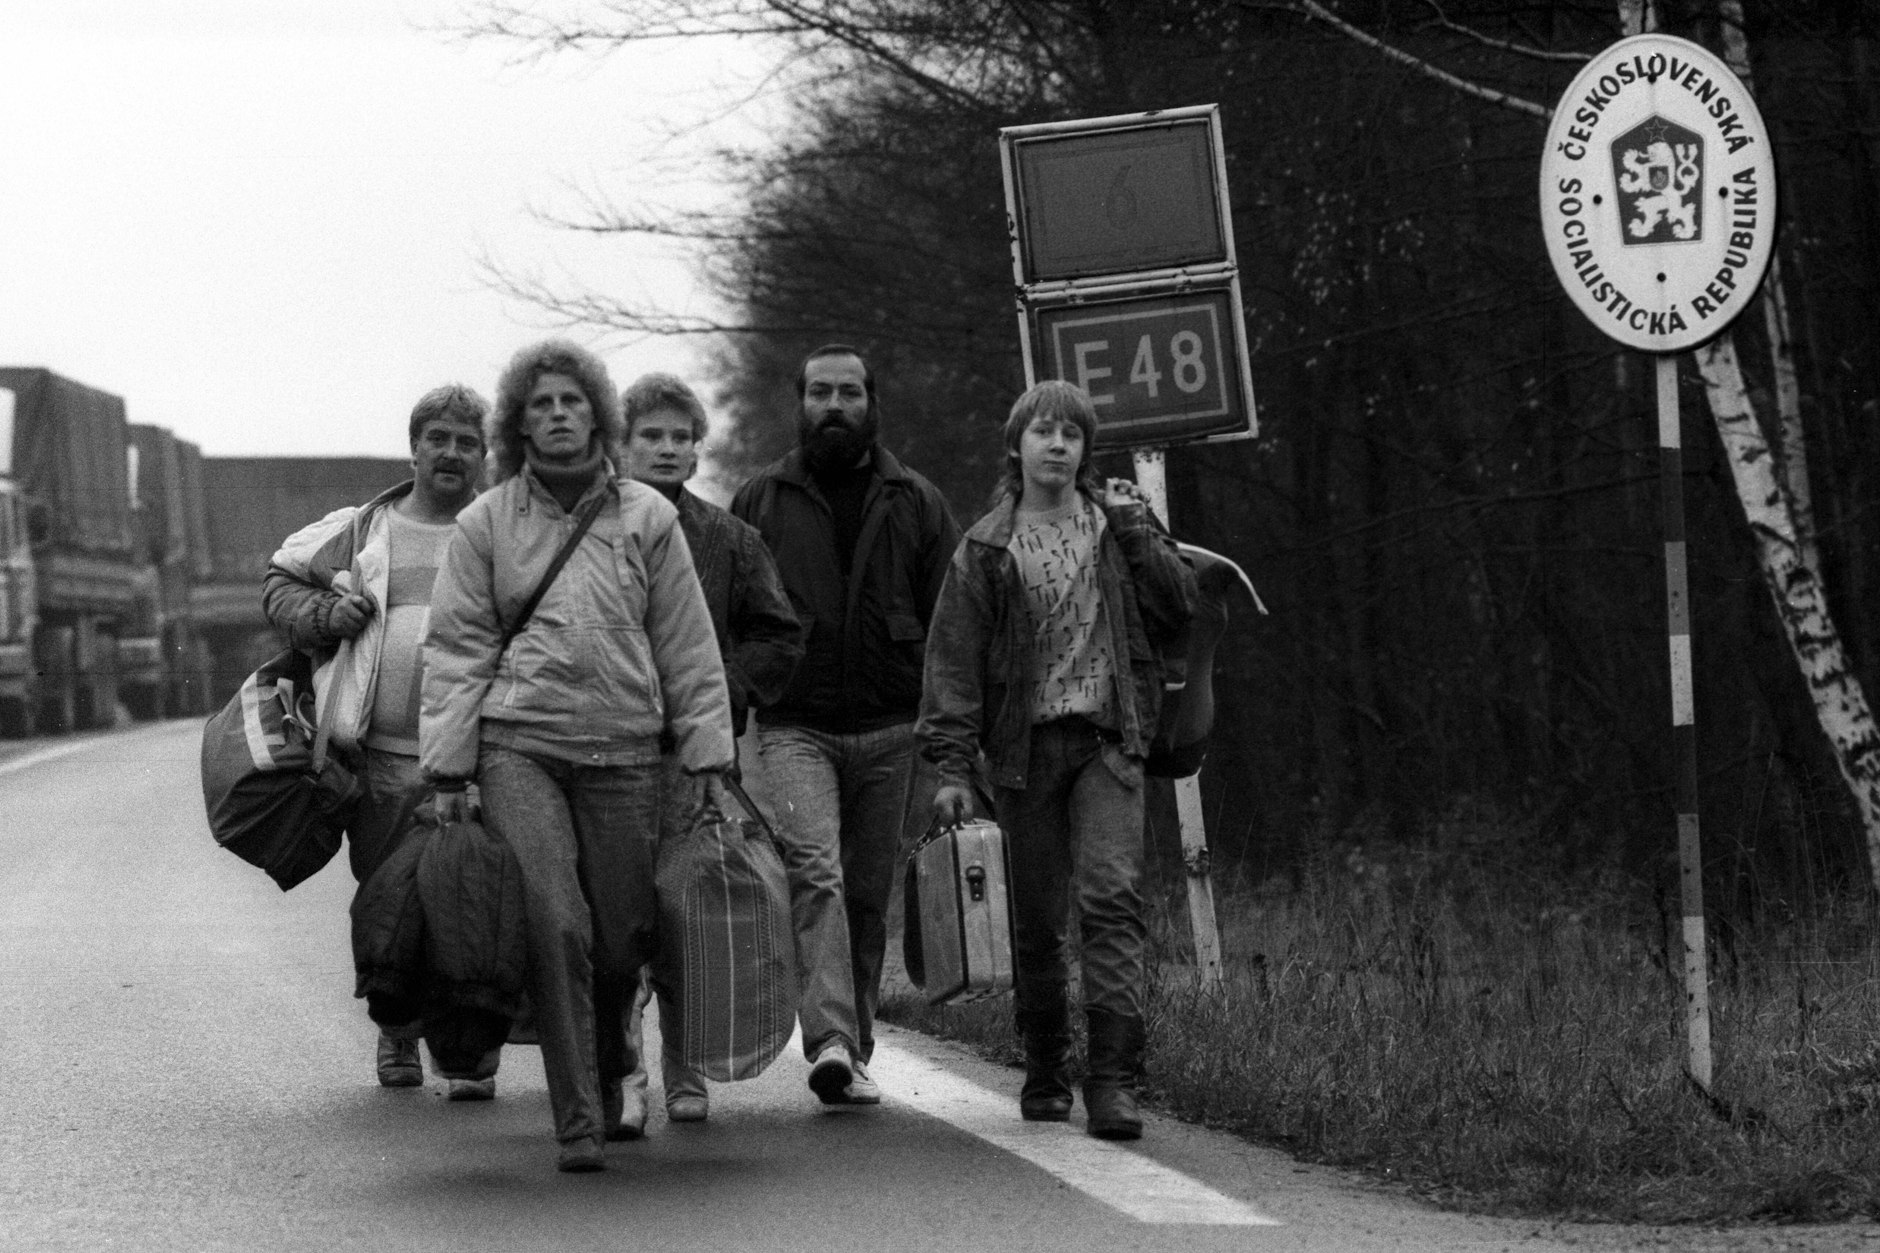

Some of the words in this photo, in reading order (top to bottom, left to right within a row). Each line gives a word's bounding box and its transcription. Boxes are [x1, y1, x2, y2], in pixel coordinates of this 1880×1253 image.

[1557, 52, 1755, 161] ČESKOSLOVENSKÁ
[1106, 164, 1138, 230] 6
[1692, 166, 1758, 319] REPUBLIKA
[1559, 178, 1688, 335] SOCIALISTICKÁ
[1130, 330, 1206, 398] 48
